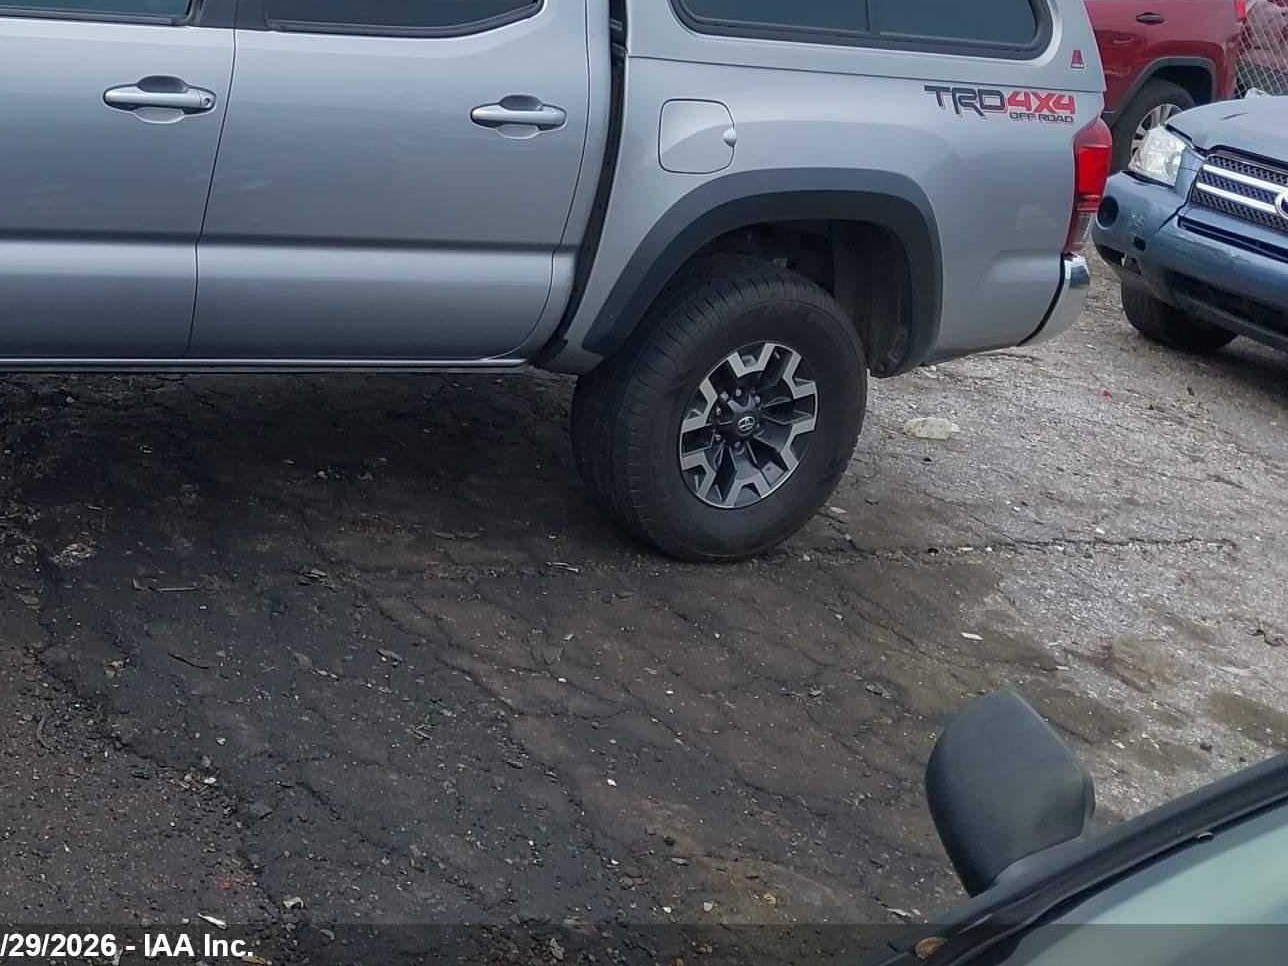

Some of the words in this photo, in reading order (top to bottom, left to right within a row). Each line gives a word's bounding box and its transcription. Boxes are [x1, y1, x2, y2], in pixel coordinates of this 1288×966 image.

[923, 84, 1008, 120] TRD
[1009, 111, 1037, 122] OFF
[1038, 113, 1075, 124] ROAD
